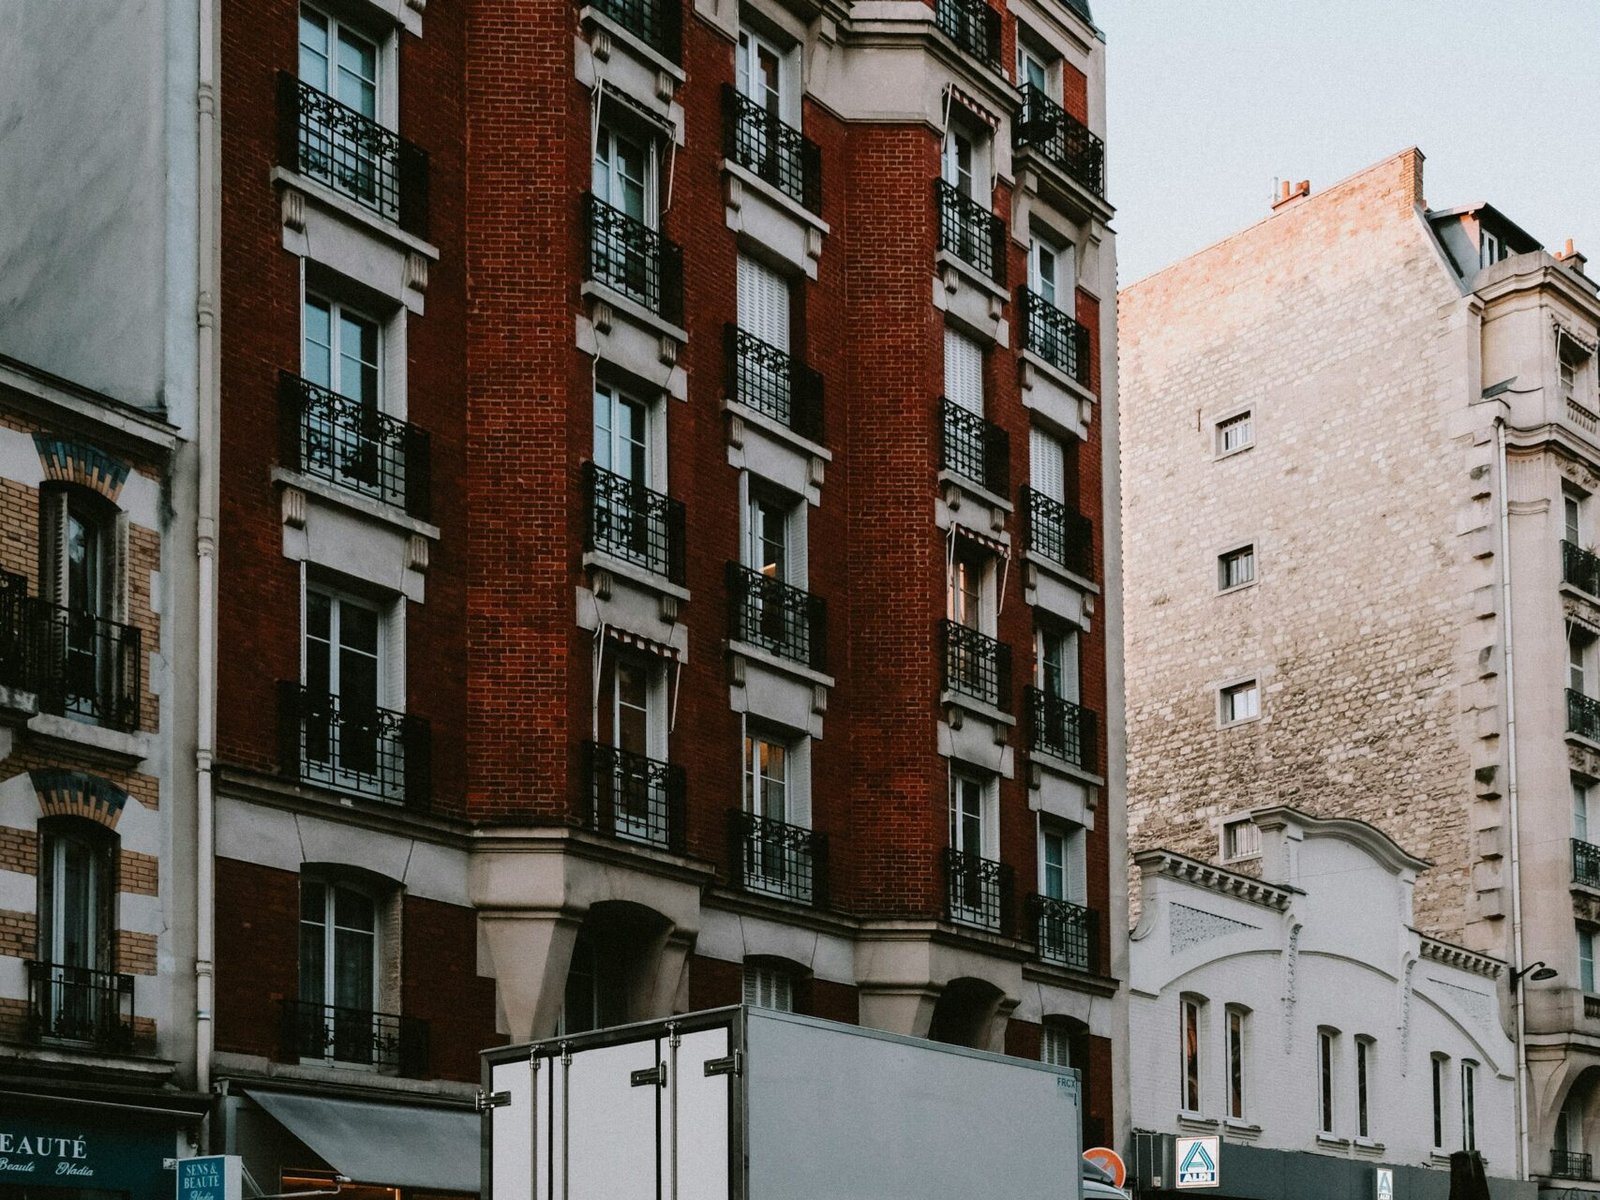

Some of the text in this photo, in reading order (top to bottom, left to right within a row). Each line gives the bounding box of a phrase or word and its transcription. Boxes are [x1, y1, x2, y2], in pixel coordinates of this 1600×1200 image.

[55, 1161, 94, 1176] Nadia
[186, 1162, 218, 1177] SENS &
[1182, 1172, 1212, 1182] ALDI
